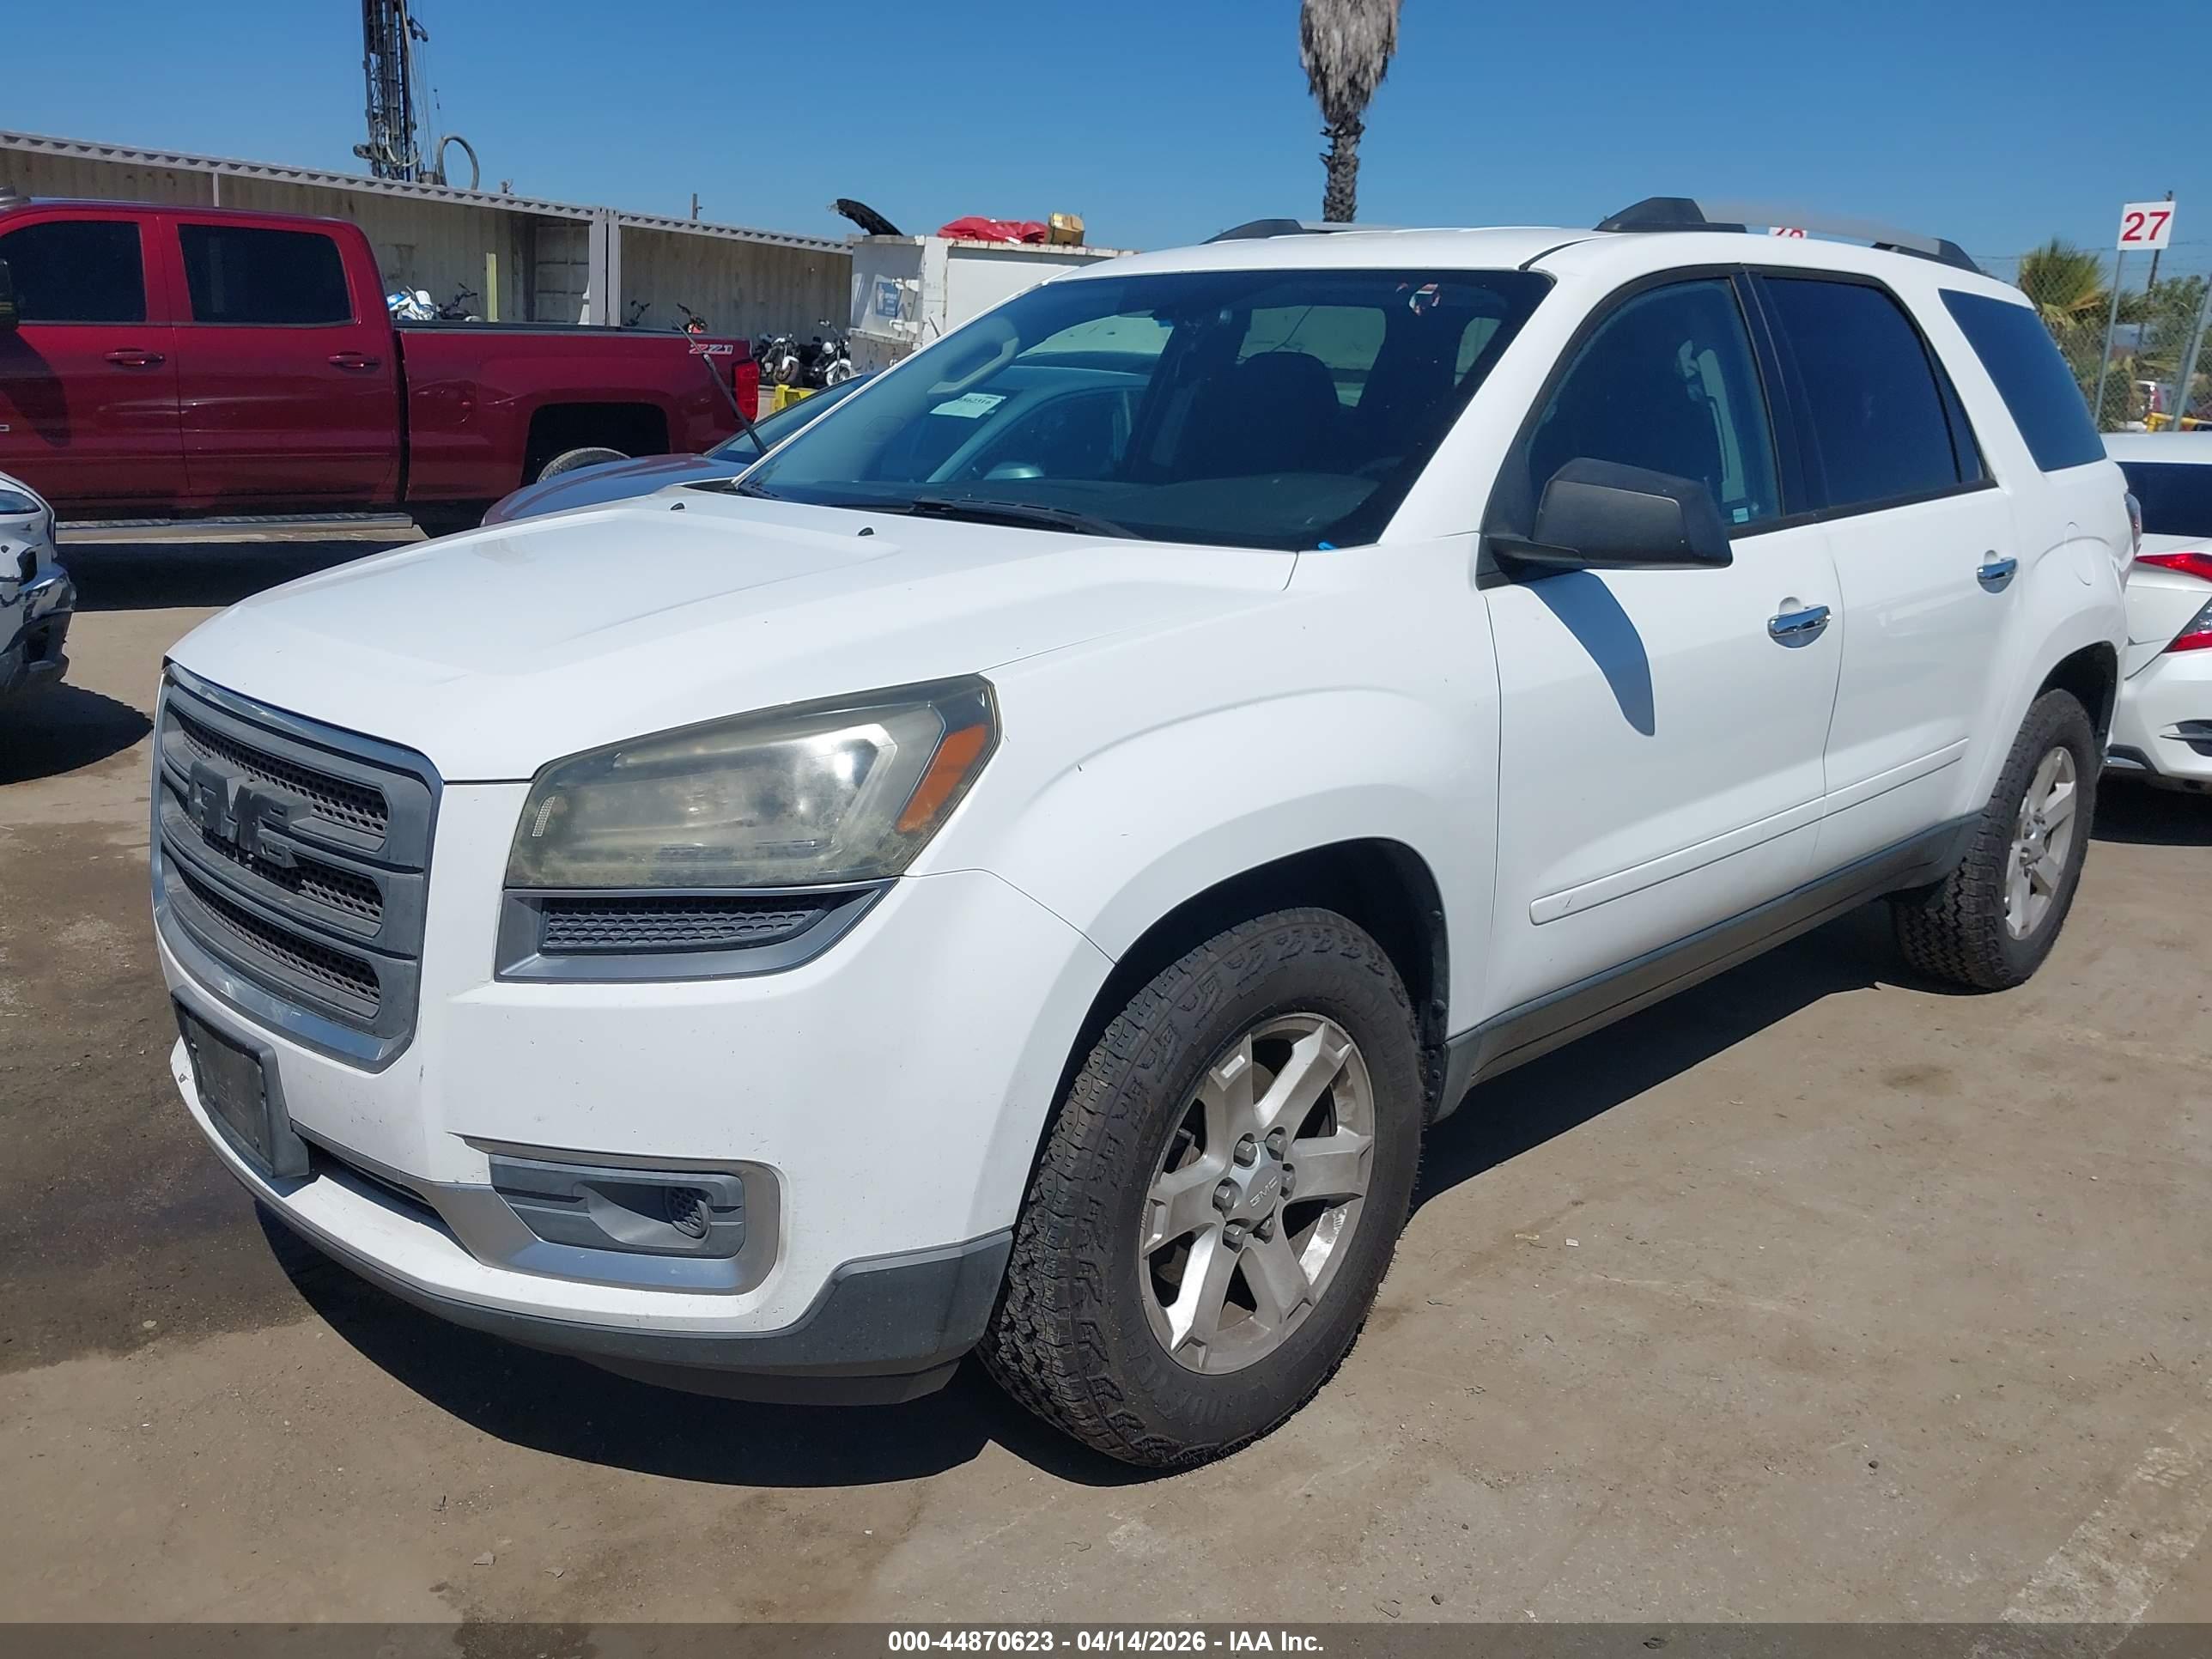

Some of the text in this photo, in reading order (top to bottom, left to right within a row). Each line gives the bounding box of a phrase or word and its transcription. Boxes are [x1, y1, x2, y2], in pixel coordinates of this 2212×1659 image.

[2122, 211, 2171, 241] 27
[188, 760, 296, 869] GMC
[1249, 1175, 1278, 1208] GMC
